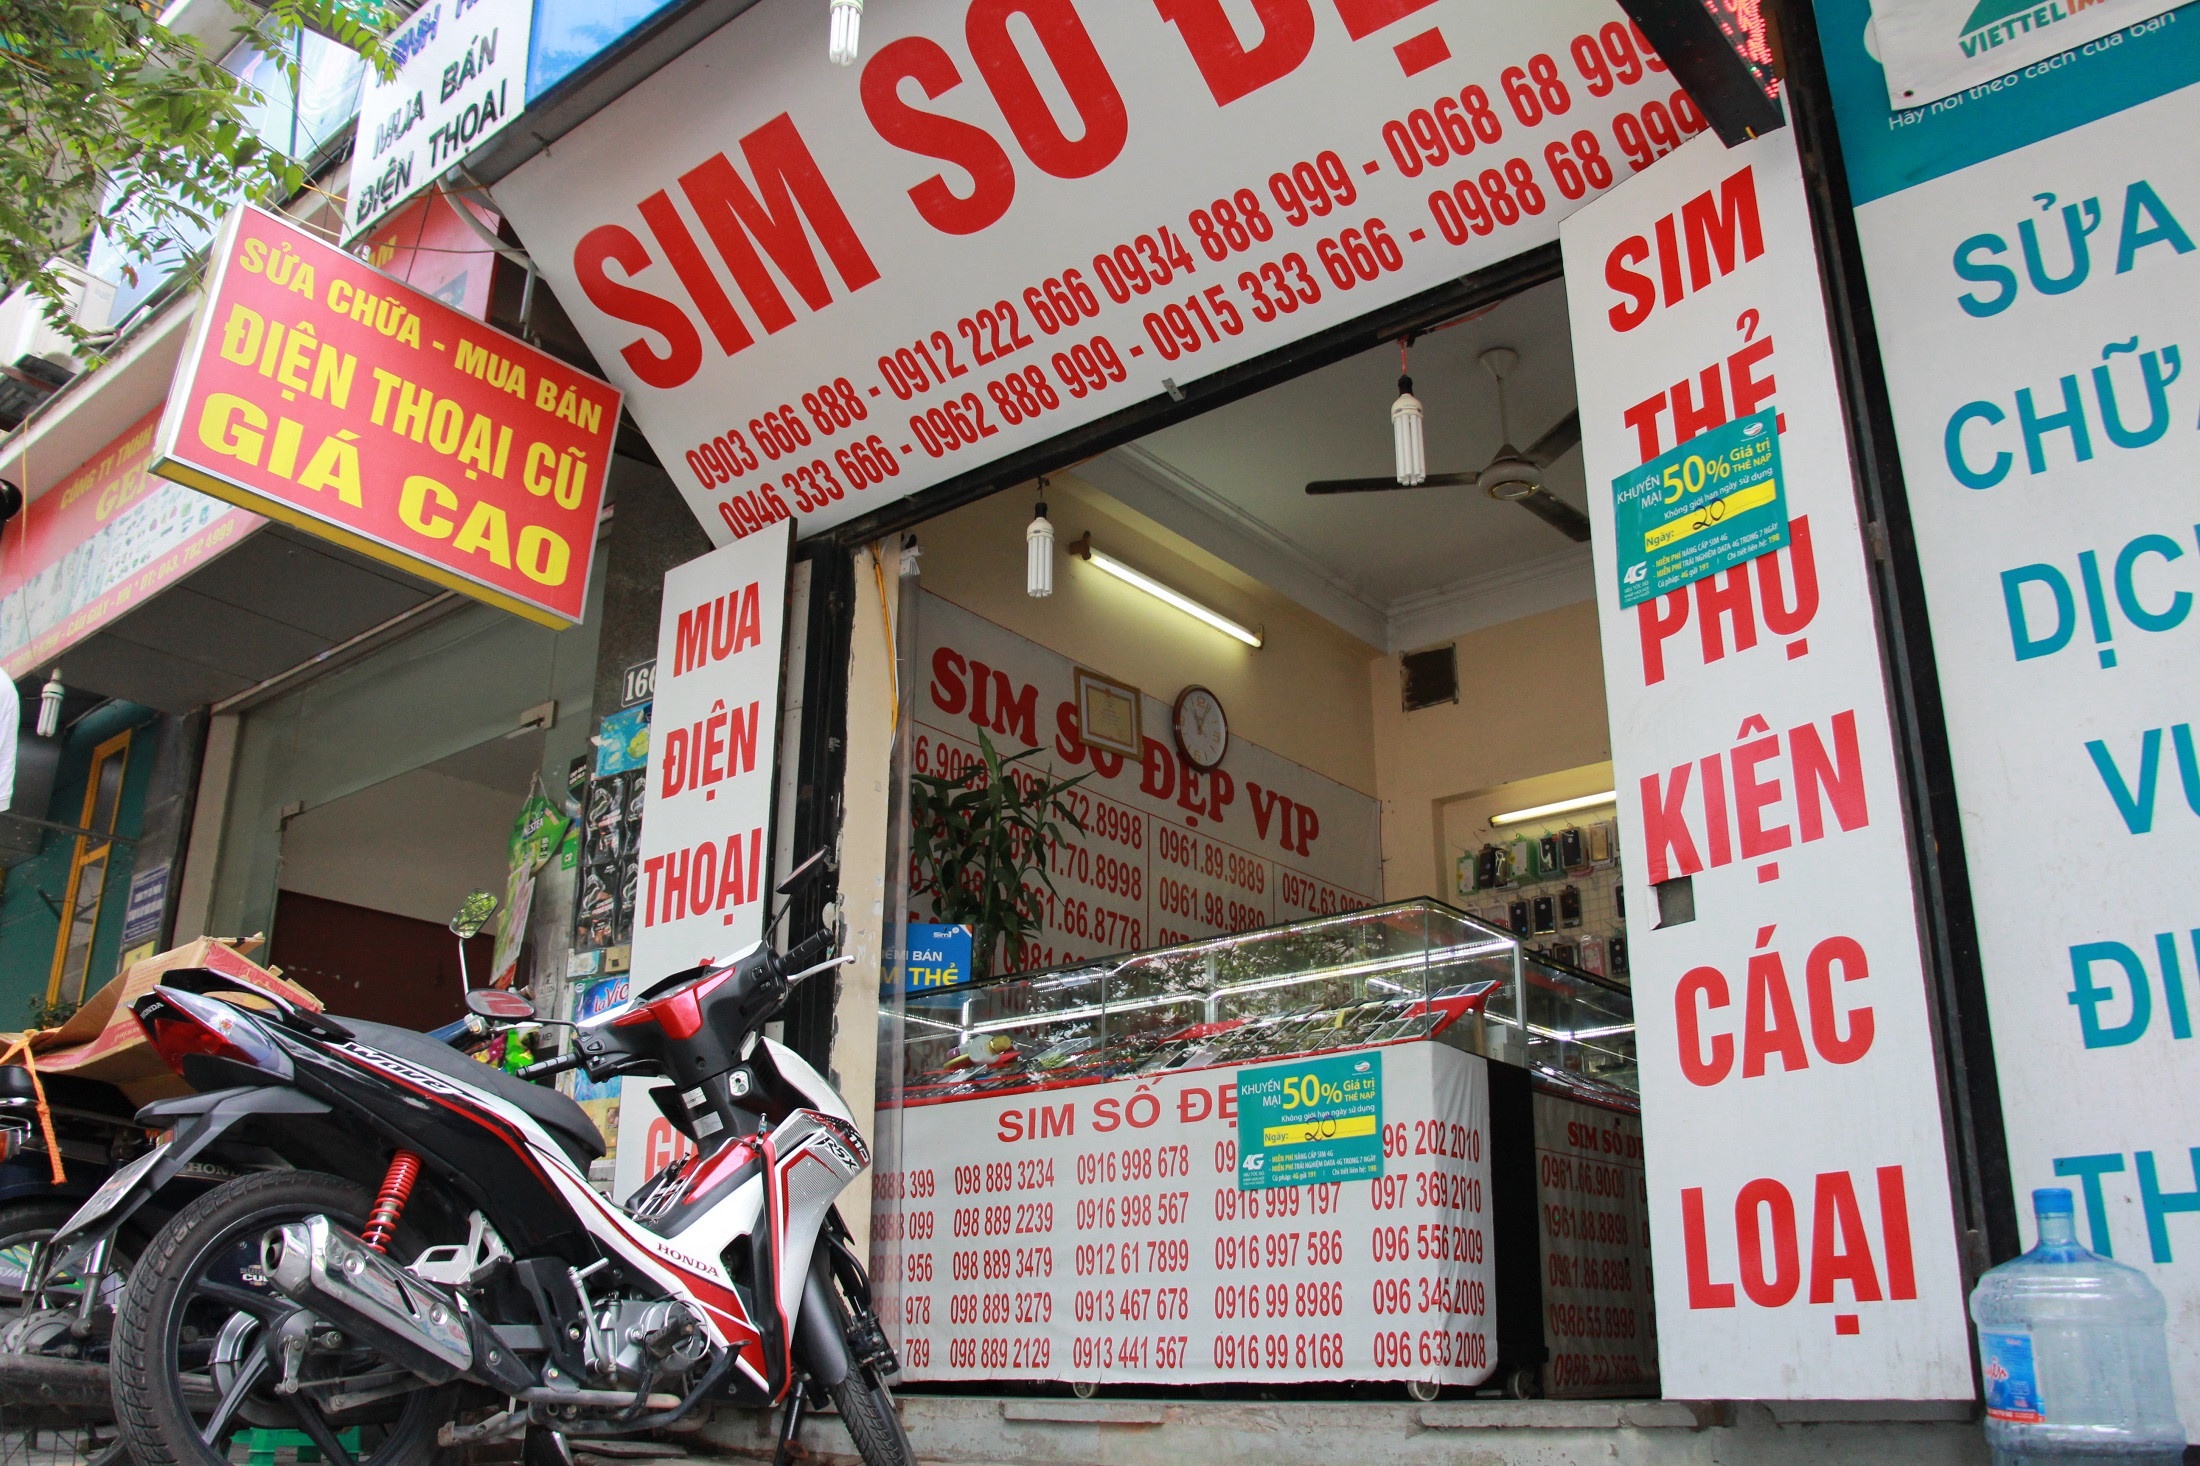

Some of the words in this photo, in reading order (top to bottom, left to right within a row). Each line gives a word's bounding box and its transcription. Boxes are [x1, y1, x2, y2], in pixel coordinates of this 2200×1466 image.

[440, 27, 498, 104] BÁN
[1889, 108, 1925, 130] Hãy
[1970, 73, 2019, 101] theo
[357, 151, 414, 225] ĐIỆN
[429, 78, 507, 167] THOẠI
[573, 111, 881, 390] SIM
[1604, 165, 1765, 333] SIM
[1952, 179, 2198, 319] SỬA
[686, 429, 760, 490] 0903
[748, 404, 812, 461] 666
[801, 377, 868, 436] 888
[878, 330, 969, 401] 0912
[957, 300, 1034, 367] 222
[1022, 268, 1101, 336] 666
[1092, 226, 1196, 304] 0934
[1188, 188, 1274, 263] 888
[1268, 150, 1358, 227] 999
[1382, 84, 1503, 178] 0968
[1500, 53, 1572, 128] 68
[241, 239, 314, 299] SỬA
[328, 280, 420, 349] CHỮA
[455, 340, 524, 398] MUA
[536, 385, 601, 433] BÁN
[718, 483, 792, 539] 0946
[782, 459, 845, 513] 333
[834, 435, 900, 490] 666
[909, 392, 999, 458] 0962
[987, 364, 1060, 426] 888
[1051, 335, 1127, 399] 999
[1143, 284, 1245, 361] 0915
[1237, 252, 1322, 323] 333
[1316, 218, 1404, 291] 666
[1428, 157, 1546, 246] 0988
[1543, 129, 1614, 200] 68
[221, 305, 357, 409] ĐIỆN
[371, 368, 512, 480] THOẠI
[524, 442, 587, 510] CŨ
[1944, 336, 2200, 490] CHỮ
[199, 394, 362, 508] GIÁ
[398, 476, 570, 586] CAO
[1617, 475, 1660, 504] KHUYẾN
[1664, 455, 1730, 504] 50%
[1730, 443, 1753, 461] Giá
[1756, 437, 1770, 451] trị
[1641, 491, 1662, 509] MẠI
[1733, 459, 1751, 473] THẺ
[1753, 453, 1772, 466] NẠP
[1664, 505, 1687, 520] Không
[1719, 482, 1737, 494] ngày
[1751, 468, 1773, 481] dụng
[1692, 498, 1726, 530] 20
[1646, 530, 1675, 547] Ngày:
[1624, 561, 1647, 583] 4G
[2000, 523, 2200, 669] DỊC
[673, 582, 761, 678] MUA
[661, 699, 760, 801] ĐIỆN
[930, 647, 1039, 747] SIM
[1246, 782, 1320, 858] VIP
[1640, 709, 1869, 886] KIỆN
[644, 828, 762, 928] THOẠI
[1160, 826, 1264, 895] 0961.89.9889
[909, 963, 958, 986] THẺ
[912, 949, 942, 961] BÁN
[139, 1002, 164, 1020] HONDA
[1675, 924, 1875, 1087] CÁC
[1242, 1079, 1280, 1095] KHUYẾN
[1282, 1074, 1342, 1109] 50%
[1343, 1080, 1360, 1091] Giá
[1363, 1077, 1375, 1090] trị
[1263, 1095, 1280, 1108] MẠI
[1344, 1091, 1359, 1102] THẺ
[1360, 1092, 1375, 1102] NẠP
[998, 1103, 1075, 1143] SIM
[1092, 1084, 1161, 1132] SỐ
[1282, 1112, 1302, 1123] Không
[1331, 1107, 1347, 1117] ngày
[1357, 1104, 1375, 1115] dụng
[1305, 1115, 1336, 1142] 20
[1265, 1132, 1288, 1143] Ngày:
[1415, 1120, 1446, 1155] 202
[1450, 1123, 1480, 1163] 2010
[1568, 1121, 1597, 1150] SIM
[956, 1165, 980, 1194] 098
[986, 1162, 1012, 1192] 889
[1018, 1159, 1054, 1190] 3234
[1078, 1152, 1116, 1184] 0916
[1122, 1148, 1152, 1180] 998
[1158, 1145, 1188, 1177] 678
[1243, 1154, 1264, 1170] 4G
[910, 1170, 934, 1198] 399
[1216, 1188, 1258, 1221] 0916
[1266, 1187, 1300, 1218] 999
[1308, 1183, 1341, 1214] 197
[1372, 1174, 1408, 1210] 097
[1416, 1171, 1447, 1207] 369
[1452, 1177, 1481, 1214] 2010
[910, 1211, 934, 1239] 099
[954, 1208, 979, 1237] 098
[985, 1205, 1011, 1235] 889
[1016, 1202, 1053, 1234] 2239
[1078, 1198, 1115, 1229] 0916
[1122, 1195, 1152, 1227] 998
[1158, 1192, 1189, 1224] 567
[657, 1243, 720, 1277] HONDA
[908, 1253, 932, 1282] 956
[1680, 1165, 1917, 1335] LOẠI
[906, 1339, 929, 1367] 789
[950, 1338, 976, 1369] 098
[981, 1338, 1008, 1369] 889
[1012, 1337, 1051, 1369] 2129
[1214, 1335, 1259, 1368] 0916
[1266, 1334, 1288, 1368] 99
[1296, 1333, 1343, 1368] 8168
[1374, 1331, 1411, 1368] 096
[1418, 1330, 1452, 1367] 633
[1455, 1332, 1486, 1369] 2008
